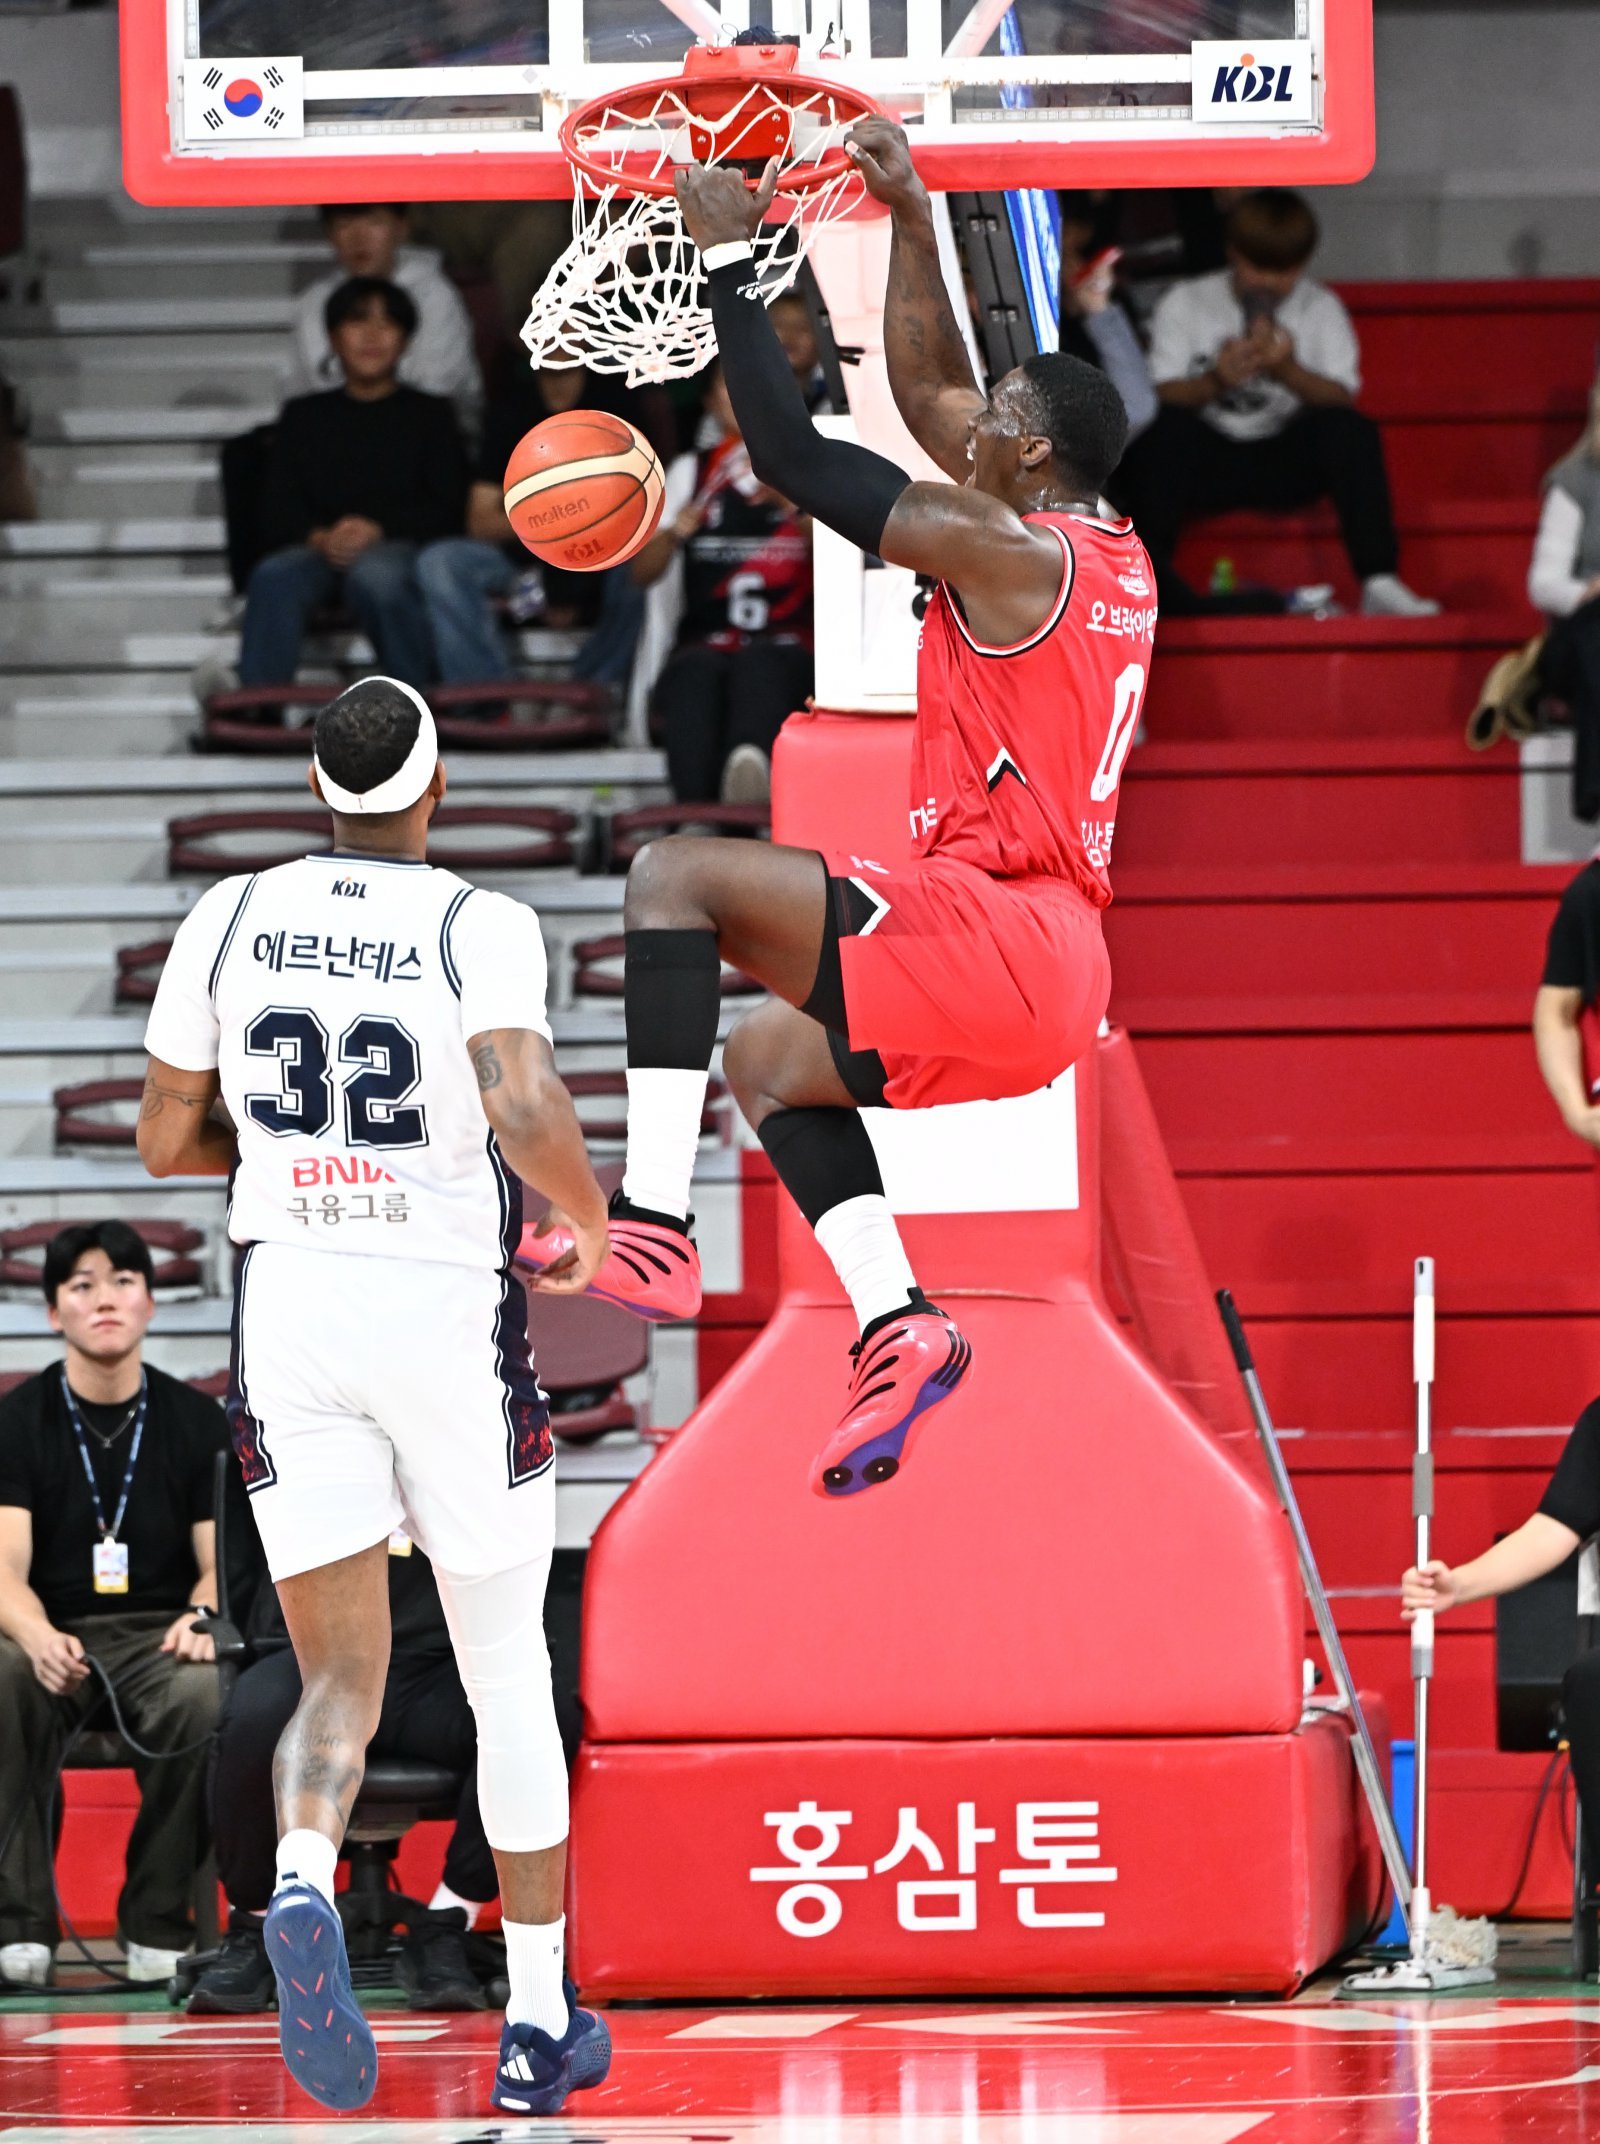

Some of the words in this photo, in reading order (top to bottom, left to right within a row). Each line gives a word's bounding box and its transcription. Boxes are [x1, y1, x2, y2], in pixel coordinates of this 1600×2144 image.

[1211, 62, 1293, 103] KBL
[527, 497, 591, 529] molten
[563, 538, 605, 562] KBL
[727, 571, 769, 632] 6
[1090, 663, 1145, 802] 0
[331, 879, 367, 899] KBL
[253, 930, 422, 983] 에르난데스
[244, 1004, 430, 1151] 32
[749, 1801, 1118, 1938] 홍삼톤
